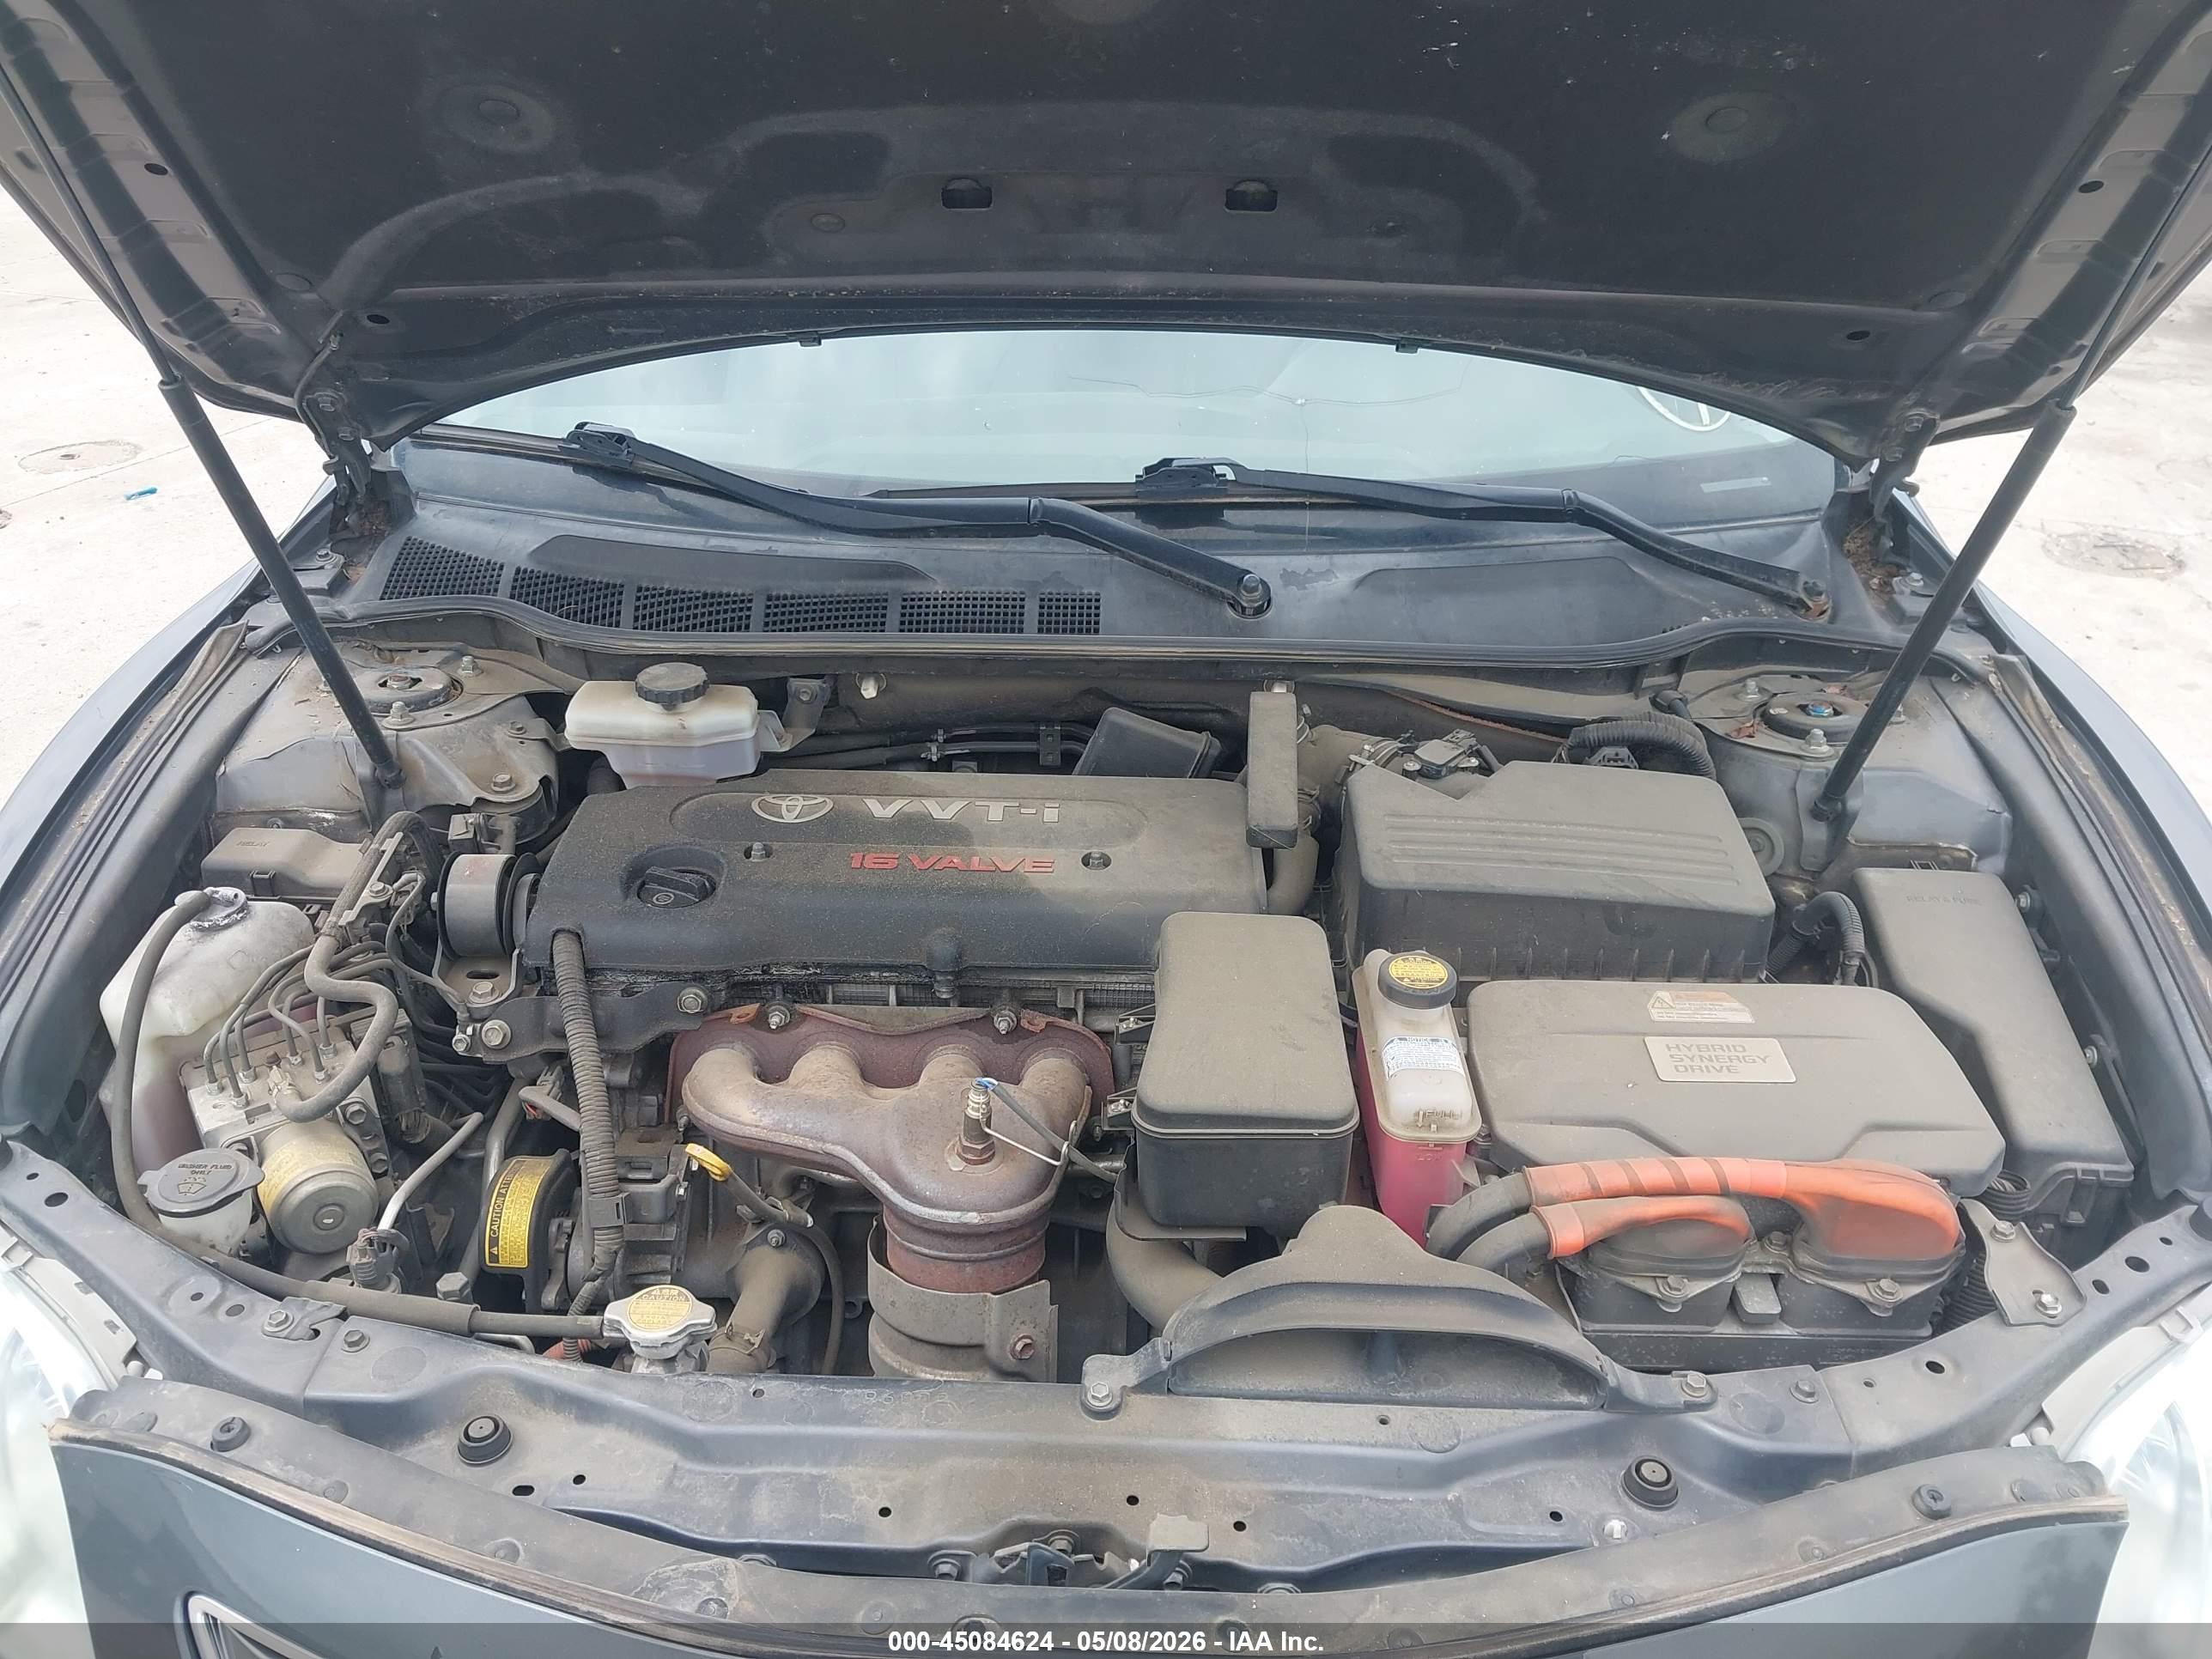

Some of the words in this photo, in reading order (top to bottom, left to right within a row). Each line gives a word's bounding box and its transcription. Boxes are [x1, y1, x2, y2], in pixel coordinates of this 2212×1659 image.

[863, 798, 1060, 823] VVT-i
[850, 852, 899, 870] 16
[908, 853, 1055, 873] VALVE
[1666, 1043, 1747, 1054] HYBRID
[1668, 1054, 1771, 1064] SYNERGY
[1675, 1064, 1740, 1074] DRIVE
[490, 1197, 505, 1237] CAUTION
